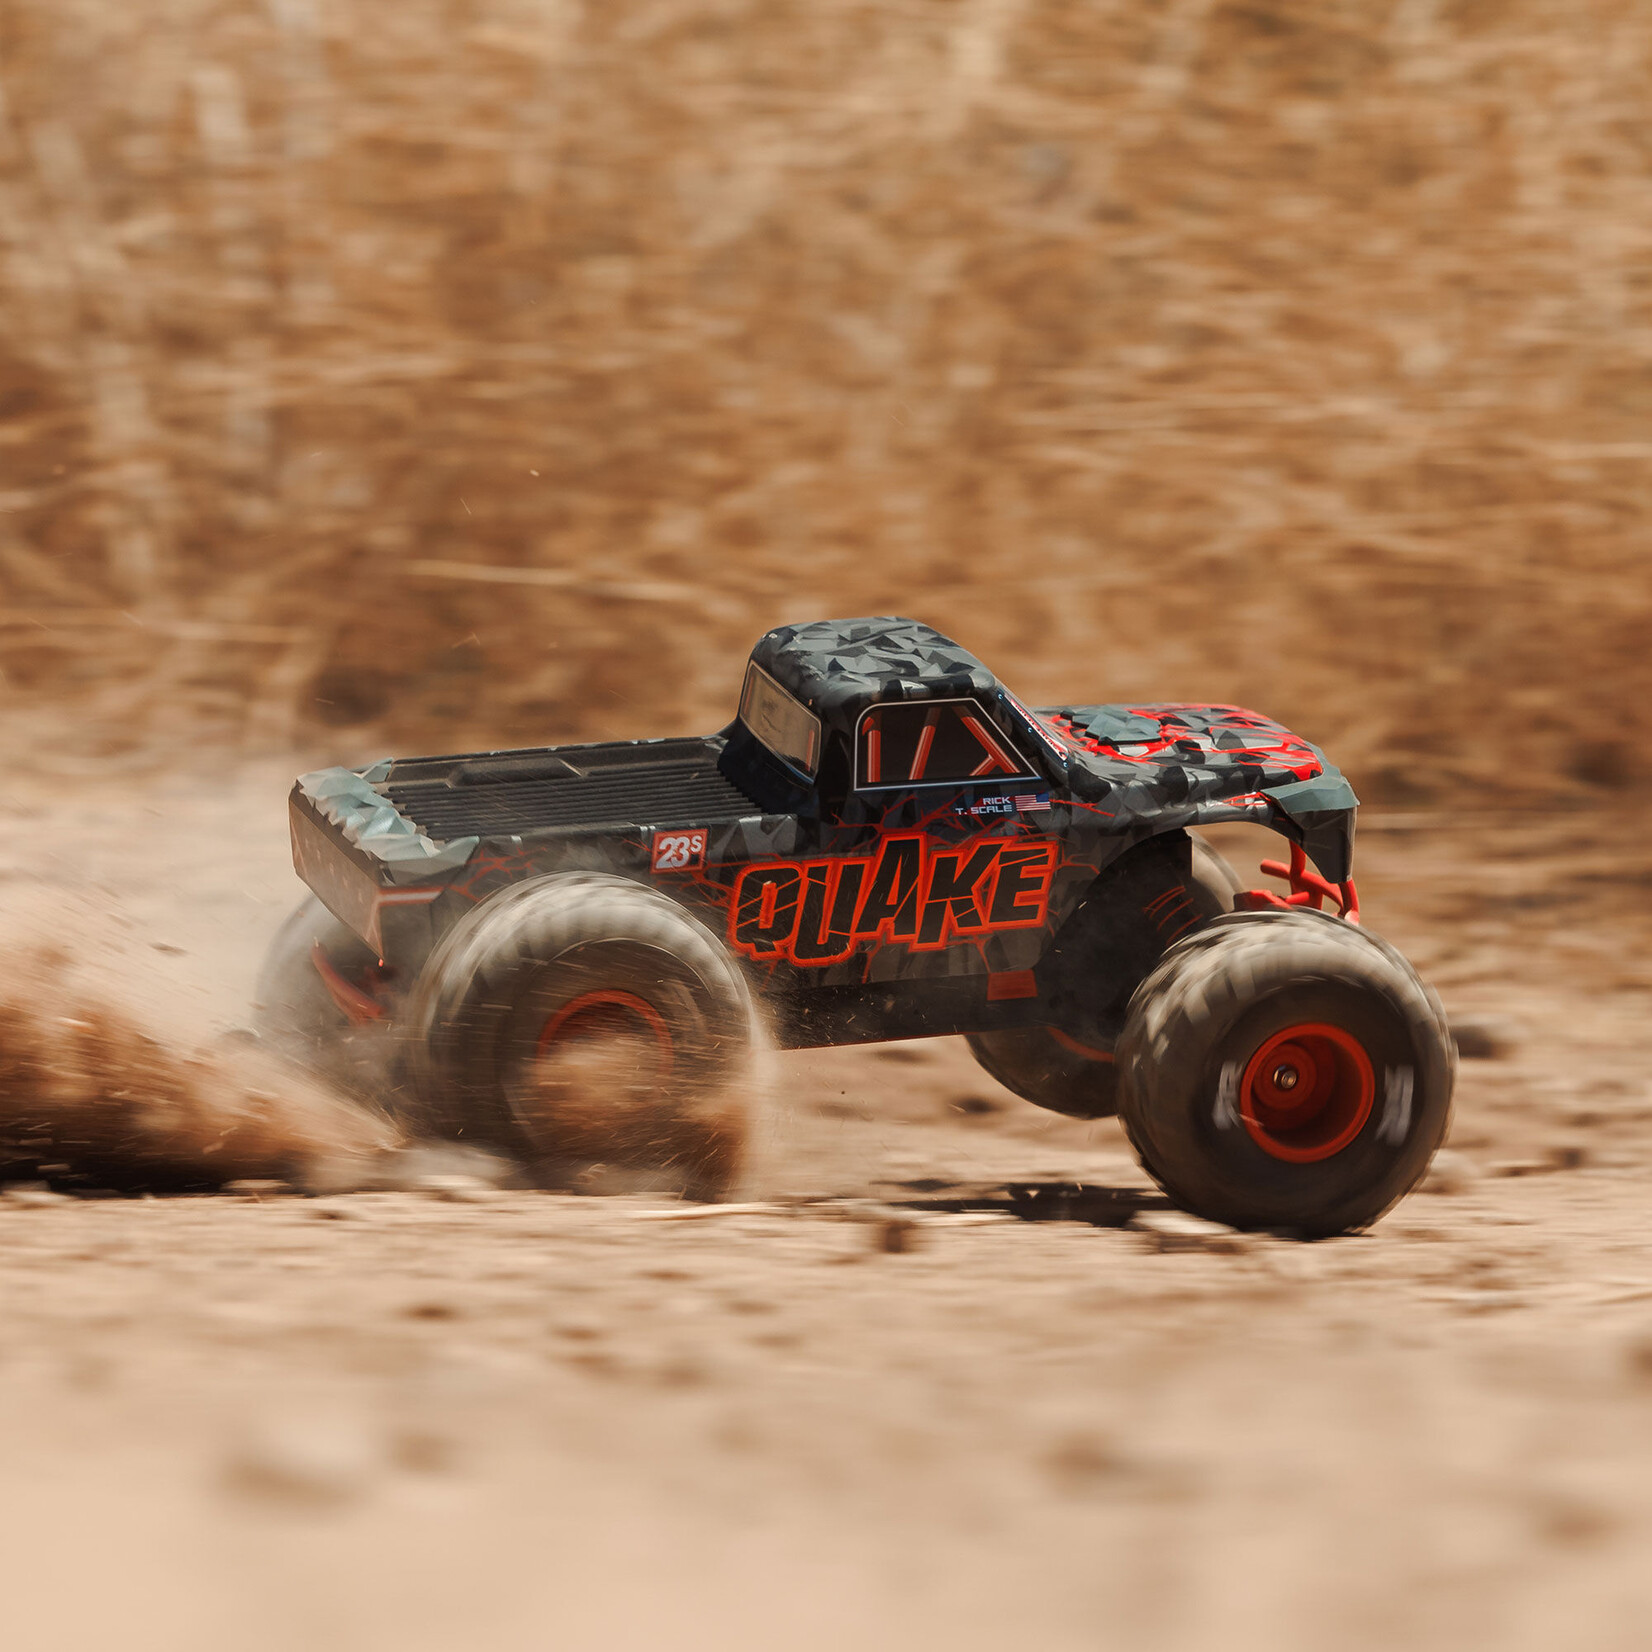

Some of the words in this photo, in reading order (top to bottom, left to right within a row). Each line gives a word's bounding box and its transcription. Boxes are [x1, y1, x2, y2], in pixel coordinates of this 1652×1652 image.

[982, 796, 1011, 806] RICK
[955, 807, 968, 816] T.
[970, 804, 1013, 815] SCALE
[729, 833, 1058, 966] QUAKE
